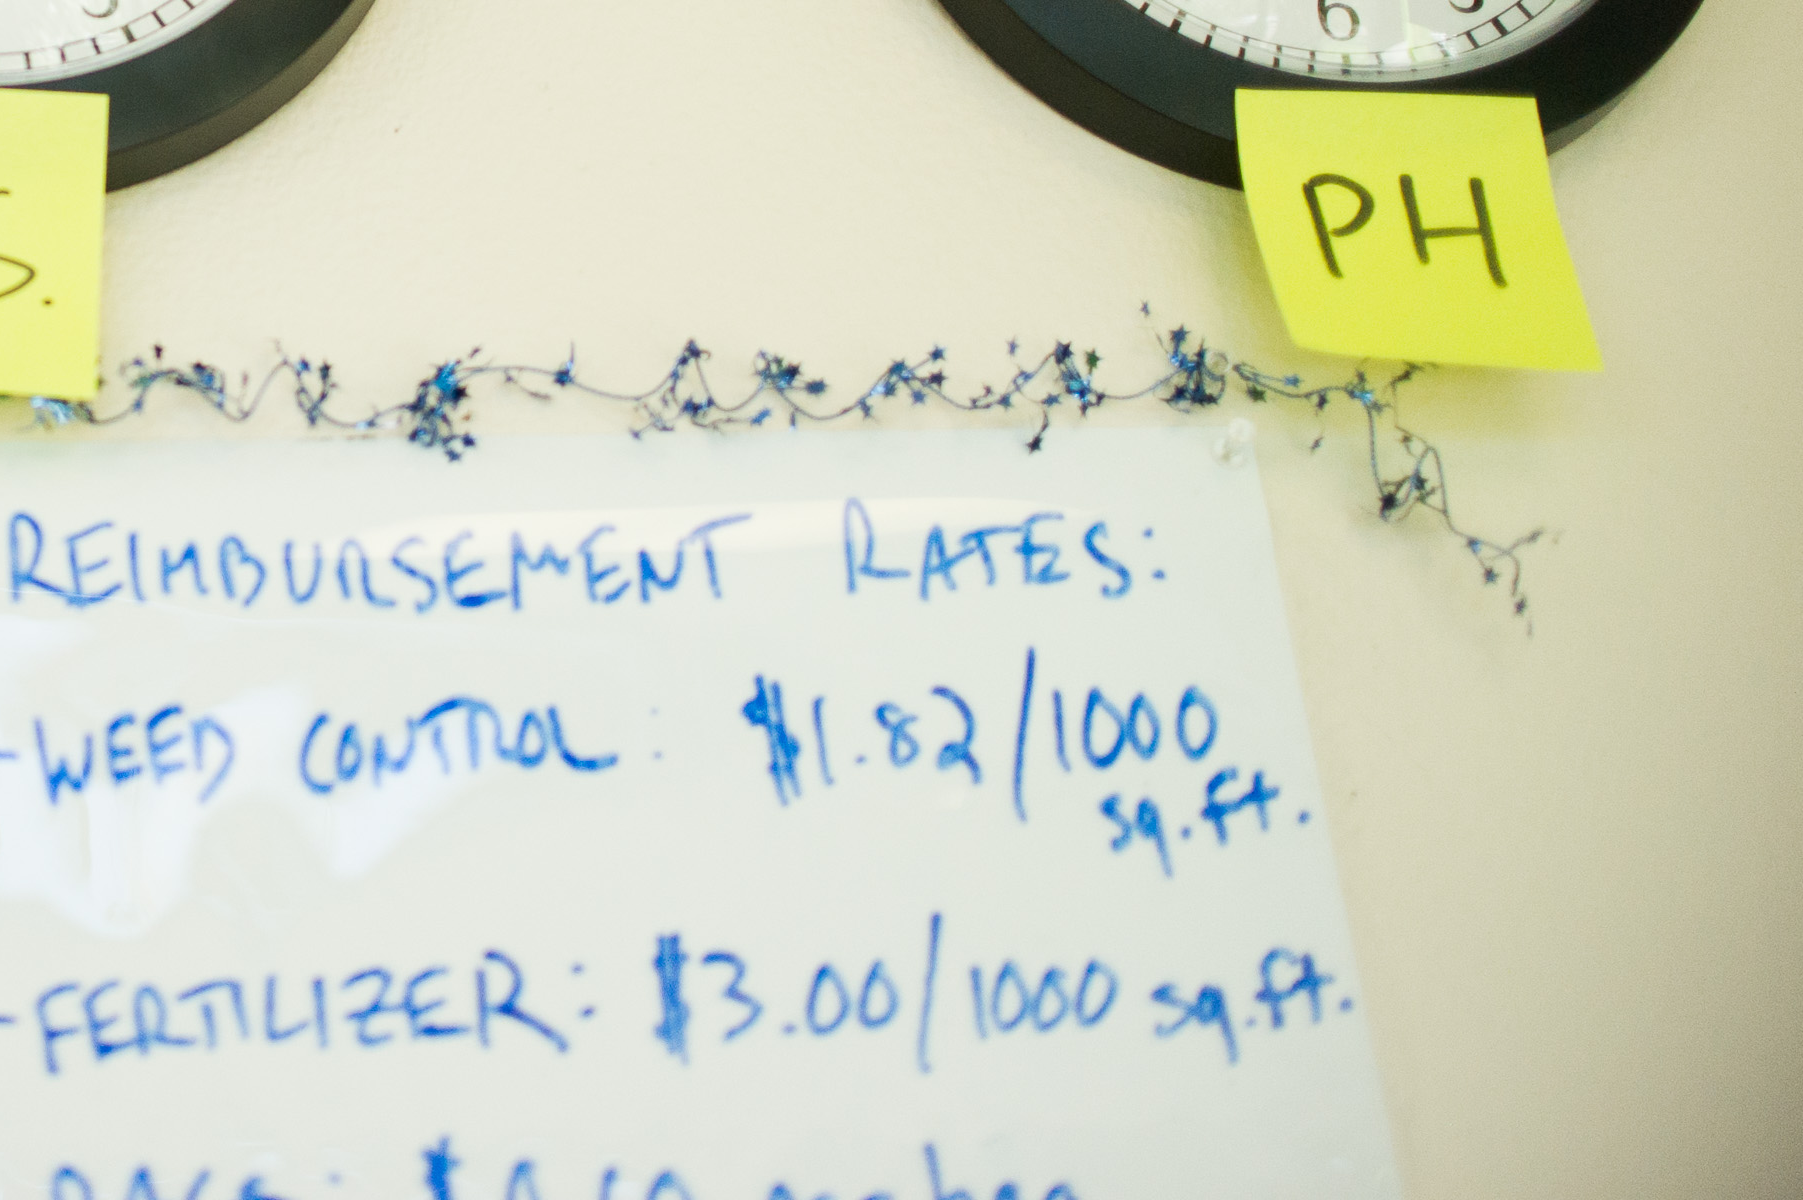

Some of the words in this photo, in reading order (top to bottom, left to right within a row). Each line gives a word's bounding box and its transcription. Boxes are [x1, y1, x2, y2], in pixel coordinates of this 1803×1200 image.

[1301, 172, 1509, 289] PH
[8, 511, 752, 614] REIMBURSEMENT
[844, 496, 1167, 601] RATES:
